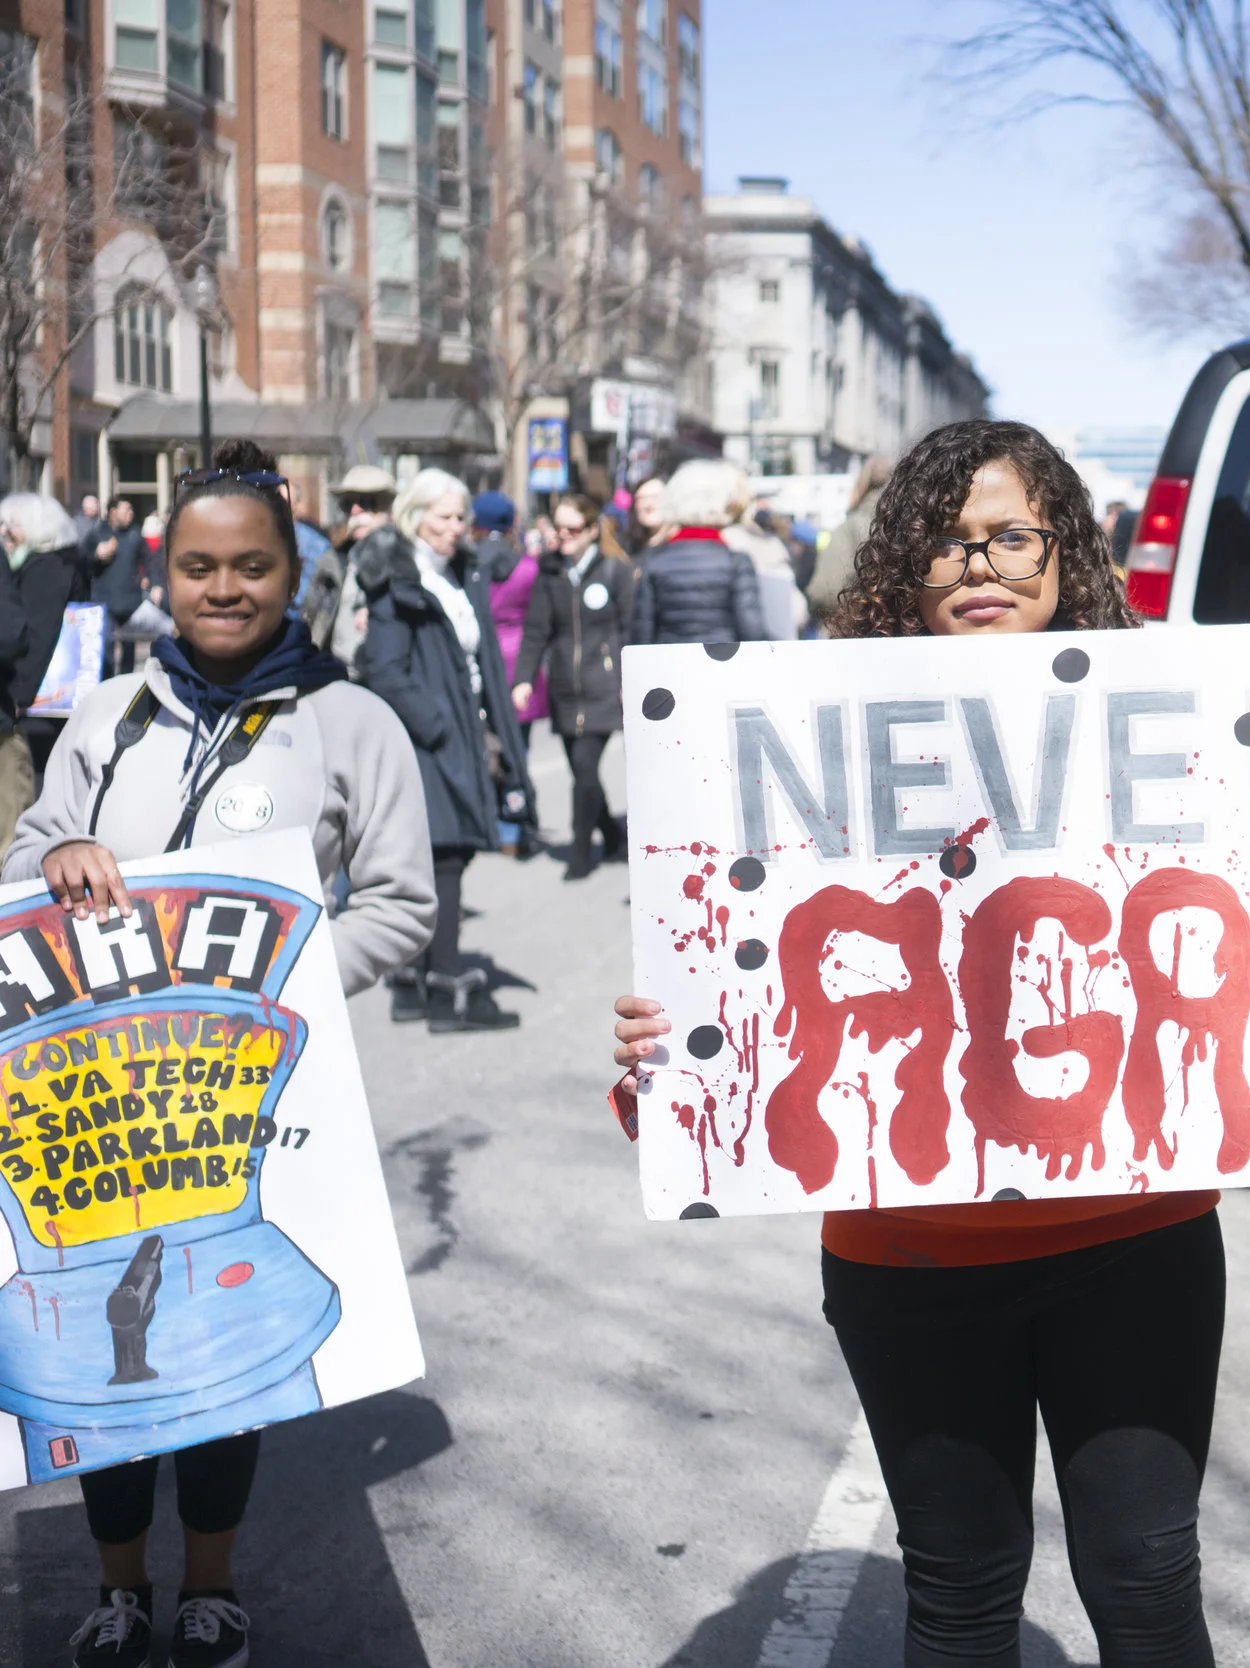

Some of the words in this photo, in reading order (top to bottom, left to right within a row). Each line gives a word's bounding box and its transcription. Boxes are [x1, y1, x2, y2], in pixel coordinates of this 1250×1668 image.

[11, 1013, 253, 1080] CONTINUE?
[48, 1070, 113, 1102] VA
[122, 1058, 236, 1090] TECH
[239, 1065, 270, 1085] 33
[35, 1089, 174, 1143] SANDY
[179, 1091, 219, 1114] 28
[42, 1114, 277, 1180] PARKLAND
[281, 1127, 311, 1149] 17
